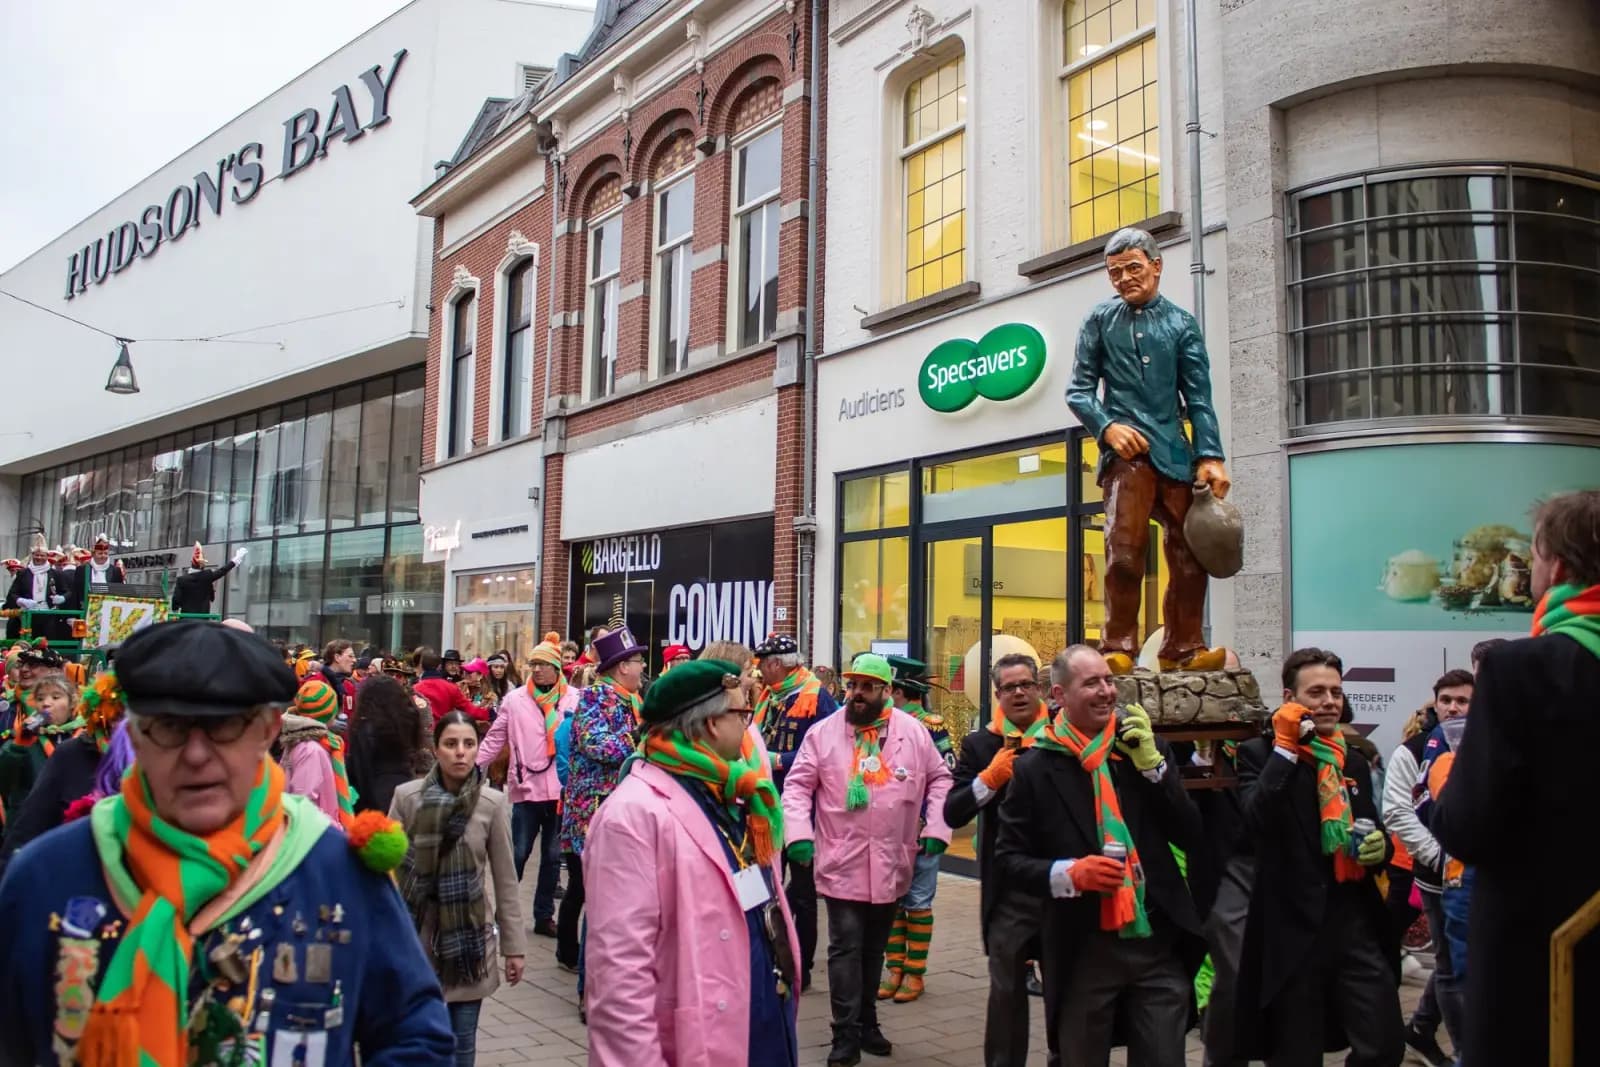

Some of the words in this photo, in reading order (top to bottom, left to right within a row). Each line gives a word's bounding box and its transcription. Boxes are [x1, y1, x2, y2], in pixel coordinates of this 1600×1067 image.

[64, 142, 263, 299] HUDSON'S
[279, 48, 408, 179] BAY
[927, 345, 1028, 392] Specsavers
[838, 387, 906, 422] Audiciens
[592, 533, 661, 575] BARGELLO
[972, 577, 1004, 590] Des
